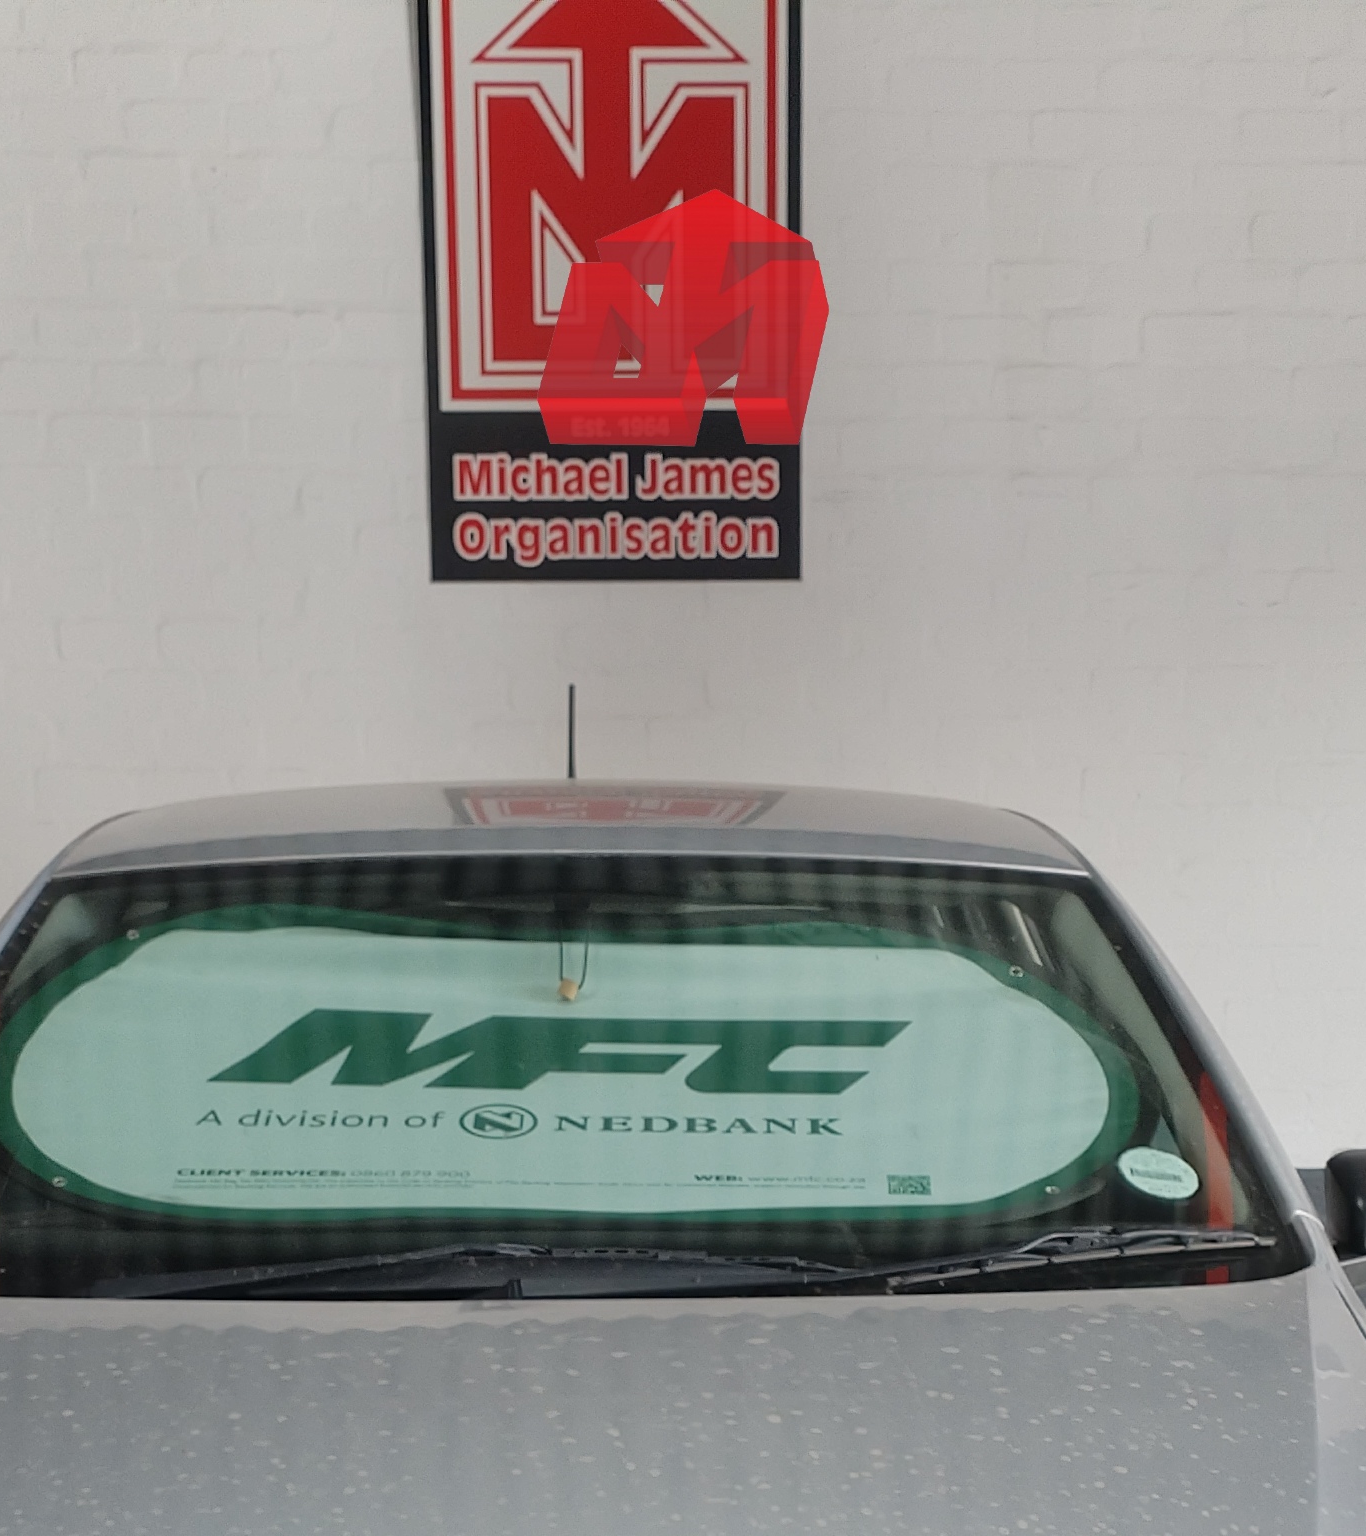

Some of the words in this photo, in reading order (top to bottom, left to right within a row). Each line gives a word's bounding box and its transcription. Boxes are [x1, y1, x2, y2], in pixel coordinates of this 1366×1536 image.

[453, 452, 629, 501] Michael
[635, 453, 781, 500] James
[453, 510, 781, 568] Organisation
[206, 1008, 912, 1094] MFC
[196, 1109, 222, 1127] A
[238, 1108, 389, 1129] division
[404, 1109, 446, 1130] of
[554, 1115, 844, 1136] NEDBANK
[177, 1168, 246, 1177] CLIENT
